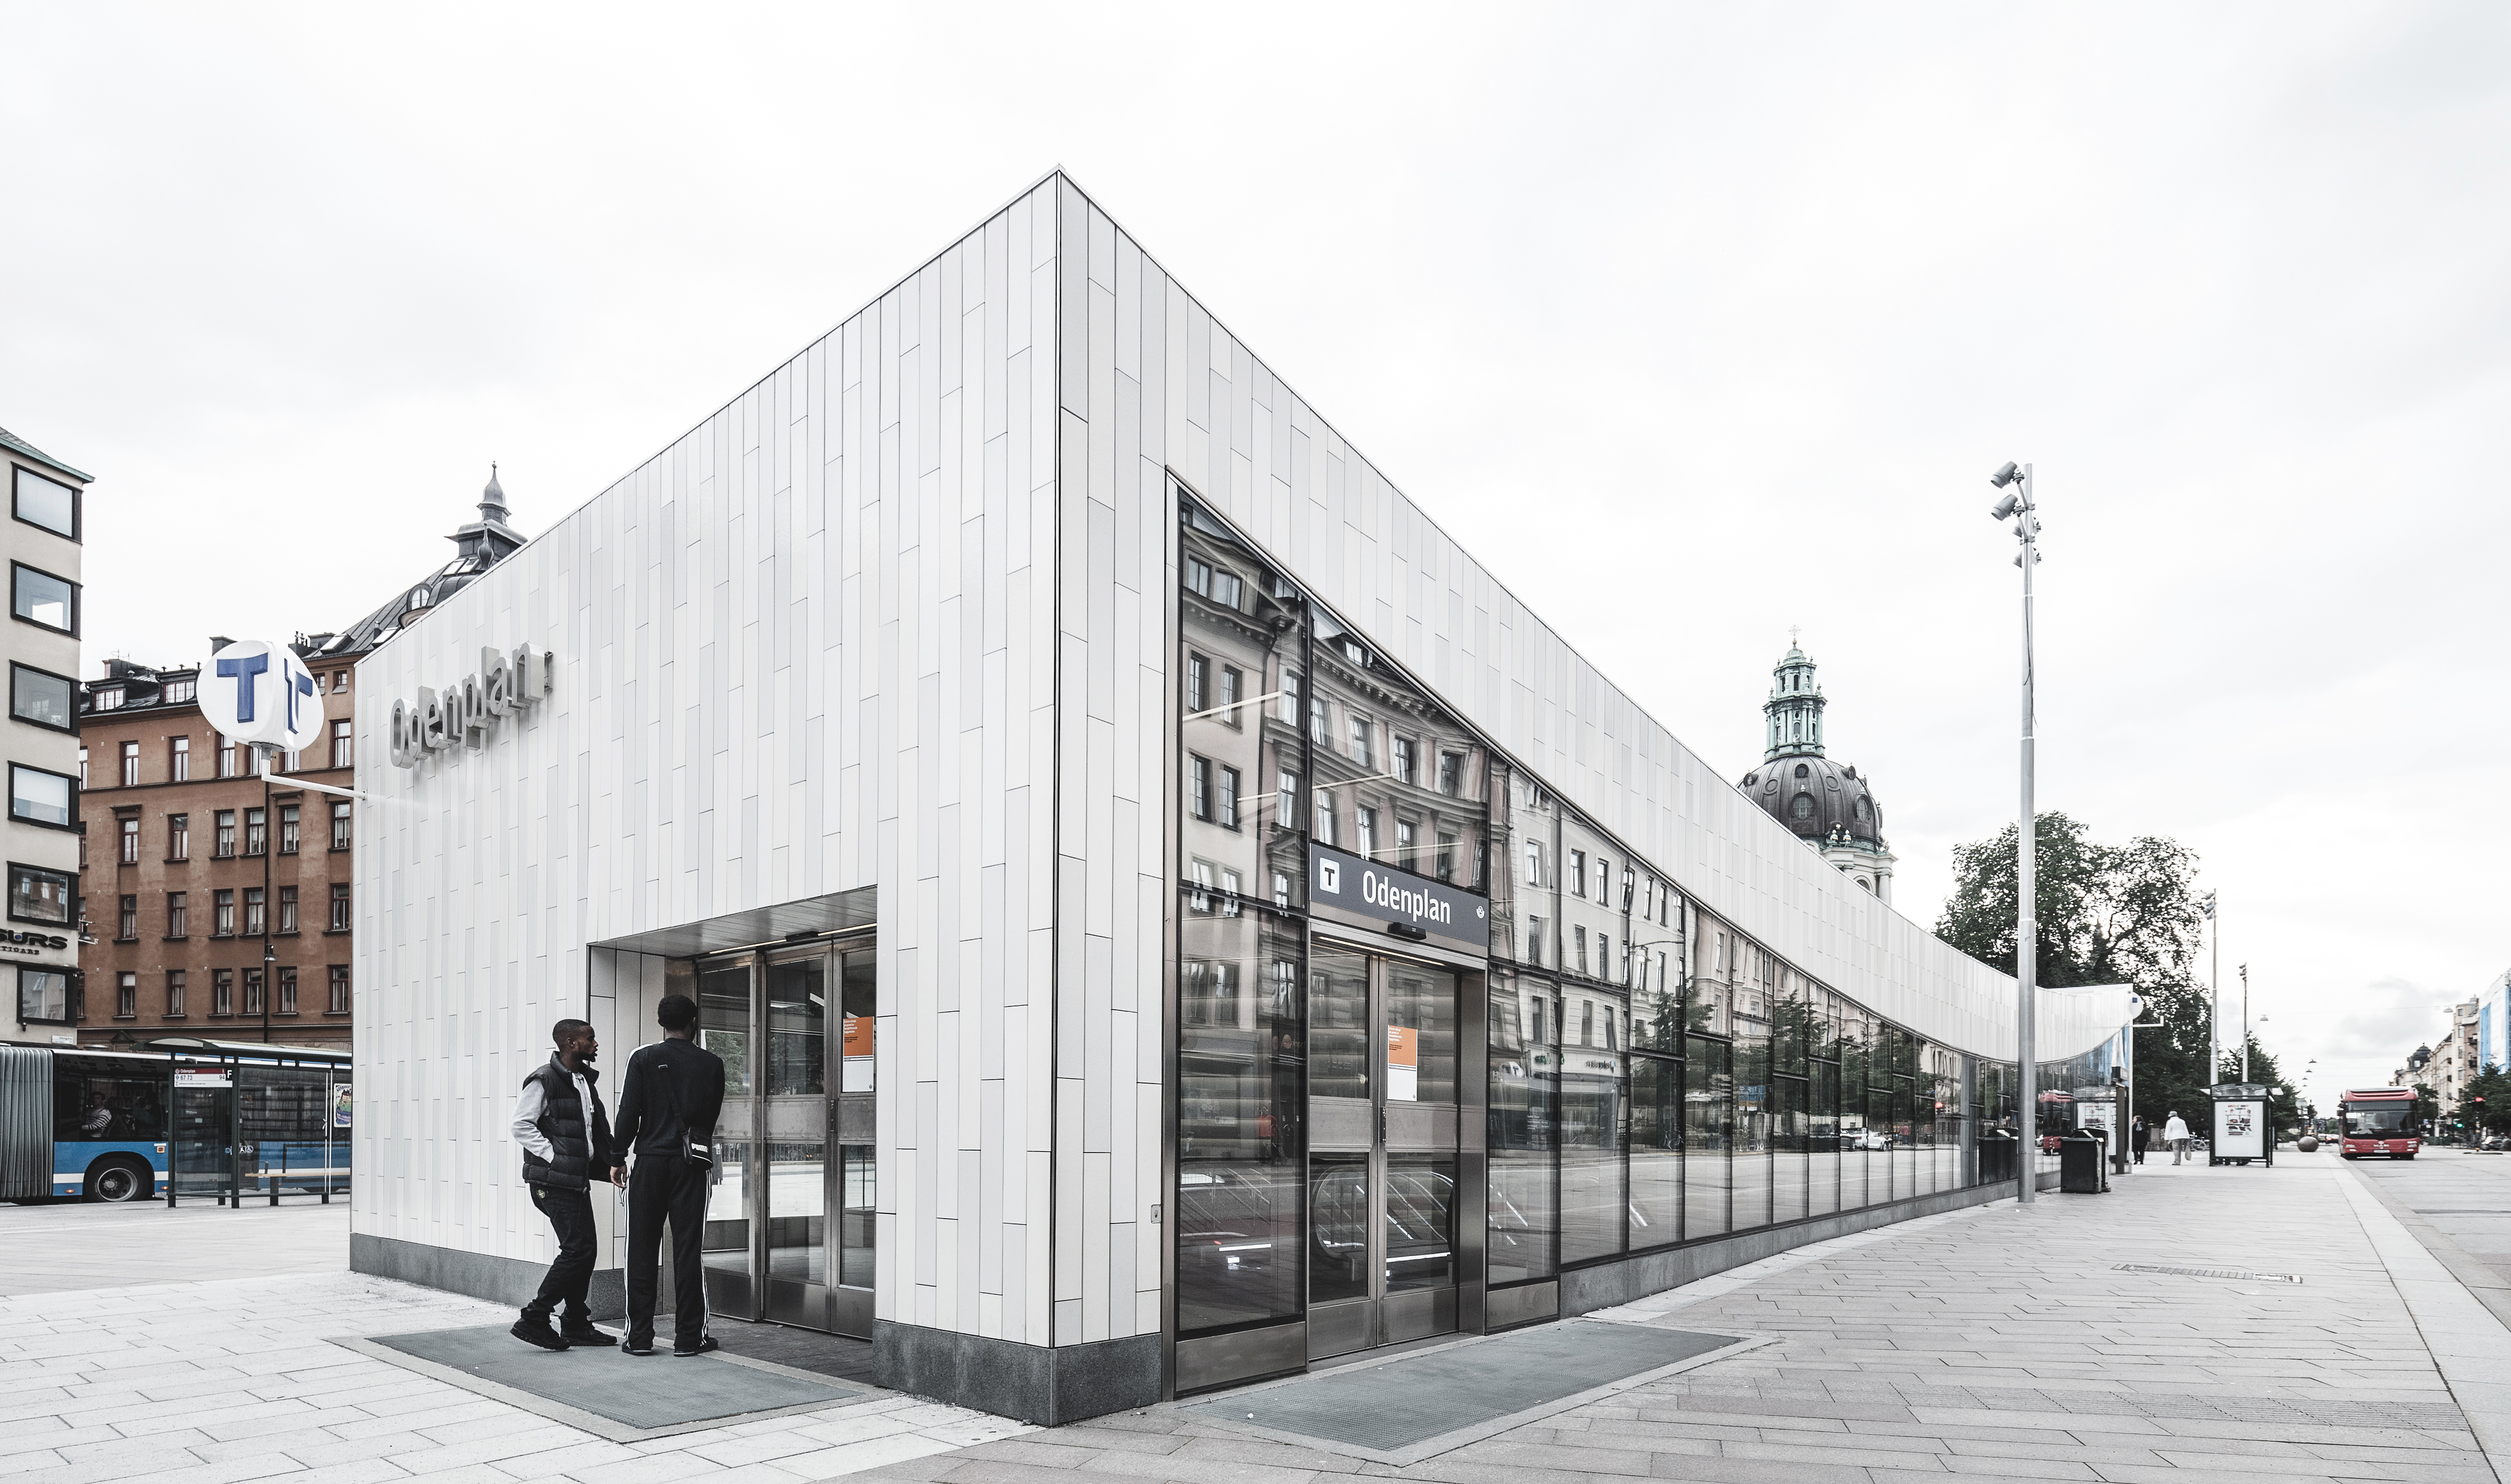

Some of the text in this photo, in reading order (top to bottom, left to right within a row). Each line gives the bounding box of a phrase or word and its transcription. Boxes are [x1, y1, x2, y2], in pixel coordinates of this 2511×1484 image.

[217, 652, 268, 723] T
[390, 642, 532, 767] Odenplan
[1324, 867, 1451, 925] T Odenplan
[227, 1070, 232, 1079] F
